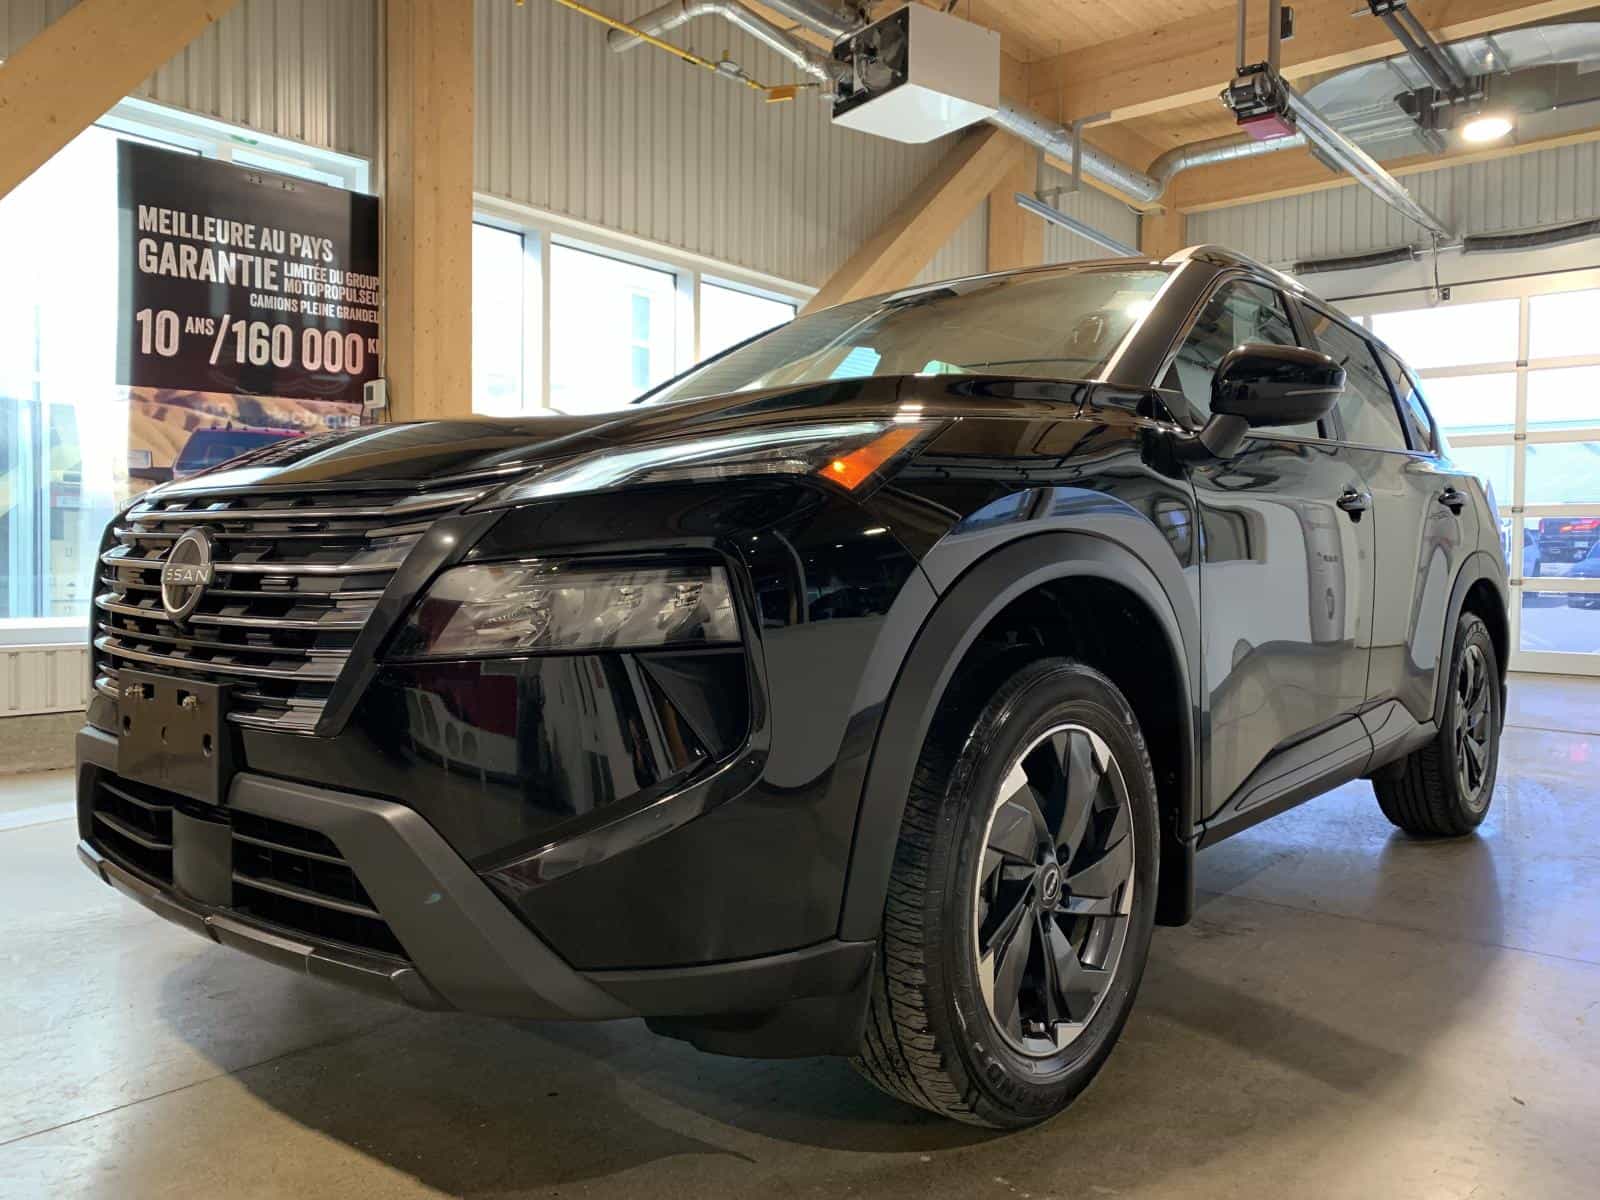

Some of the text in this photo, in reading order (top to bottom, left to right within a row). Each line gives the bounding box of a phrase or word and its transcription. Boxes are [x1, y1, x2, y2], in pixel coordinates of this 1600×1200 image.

[138, 204, 334, 262] MEILLEURE AU PAYS
[138, 238, 279, 291] GARANTIE
[284, 277, 379, 306] MOTOPROPULSEU
[329, 269, 344, 285] DU
[345, 271, 379, 290] GROUP
[250, 293, 298, 313] CAMIONS
[300, 299, 335, 318] PLEINE
[136, 308, 180, 357] 10
[184, 316, 215, 336] ANS
[302, 327, 364, 375] 000
[166, 567, 209, 583] SSAN
